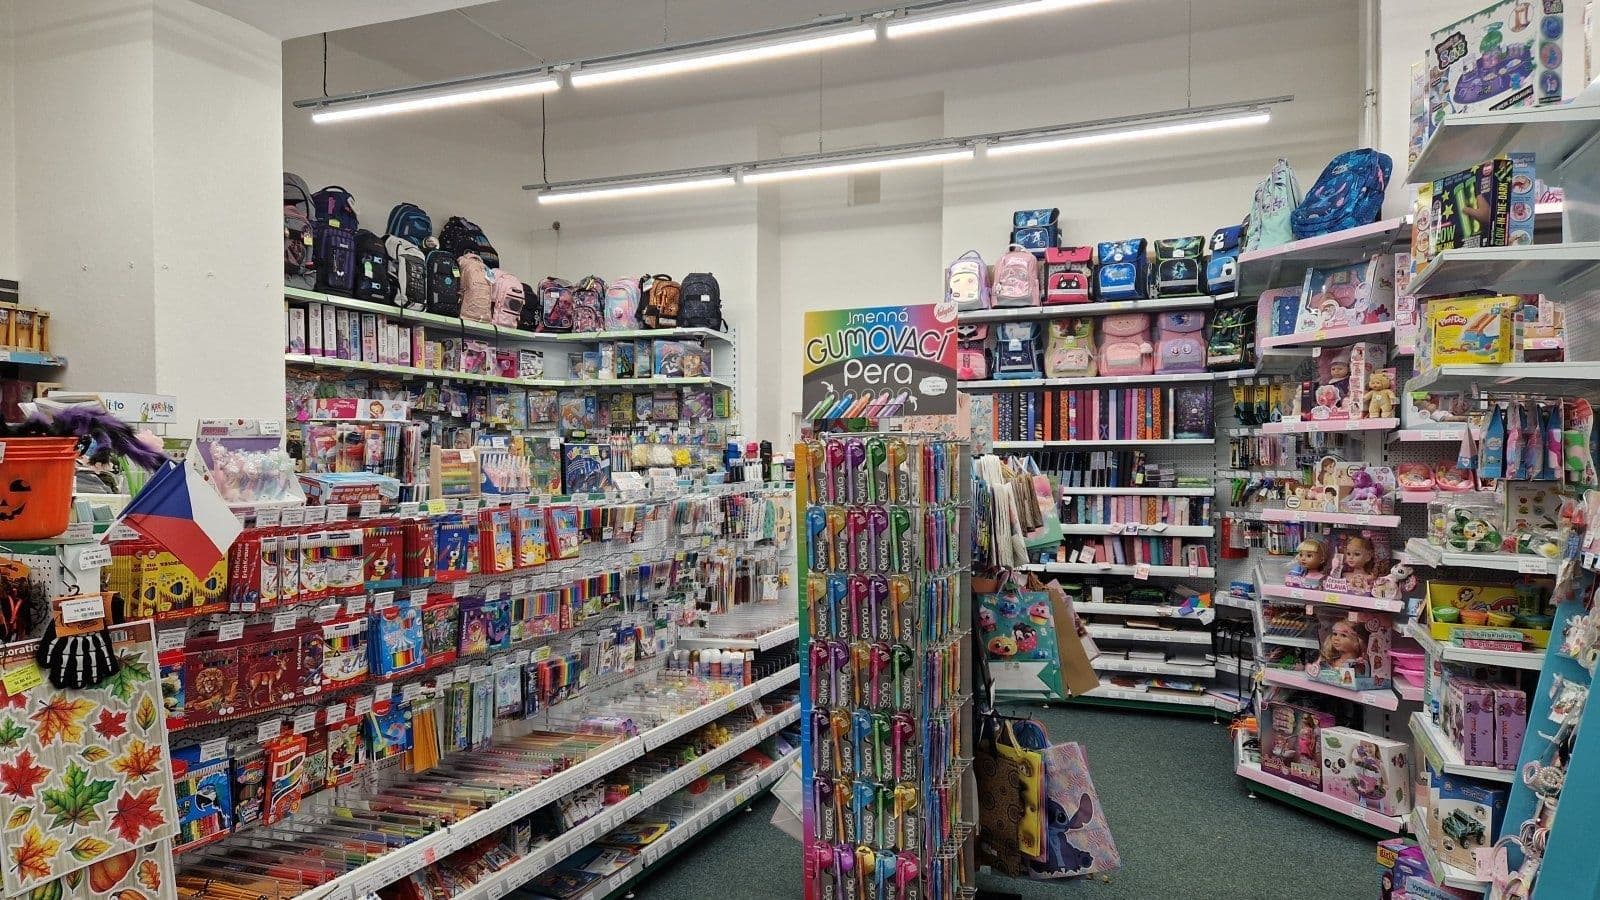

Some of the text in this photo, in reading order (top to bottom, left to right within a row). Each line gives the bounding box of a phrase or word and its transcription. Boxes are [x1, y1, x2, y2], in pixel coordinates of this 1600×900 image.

[847, 307, 909, 326] Jmenná
[806, 326, 956, 365] GUMOVACÍ
[837, 476, 845, 503] Pavla
[899, 473, 907, 502] Petra
[241, 542, 249, 579] ErichKrause
[817, 541, 825, 570] Radek
[839, 541, 847, 570] Radim
[859, 541, 867, 570] Radka
[879, 540, 887, 571] Renata
[1325, 583, 1347, 591] HLAVA
[818, 606, 826, 637] Robert
[839, 607, 847, 638] Roman
[880, 608, 888, 640] Sabina
[819, 680, 827, 705] Silvie
[862, 748, 872, 777] Šimon
[864, 815, 873, 844] Tomáš
[907, 817, 915, 850] Vendula
